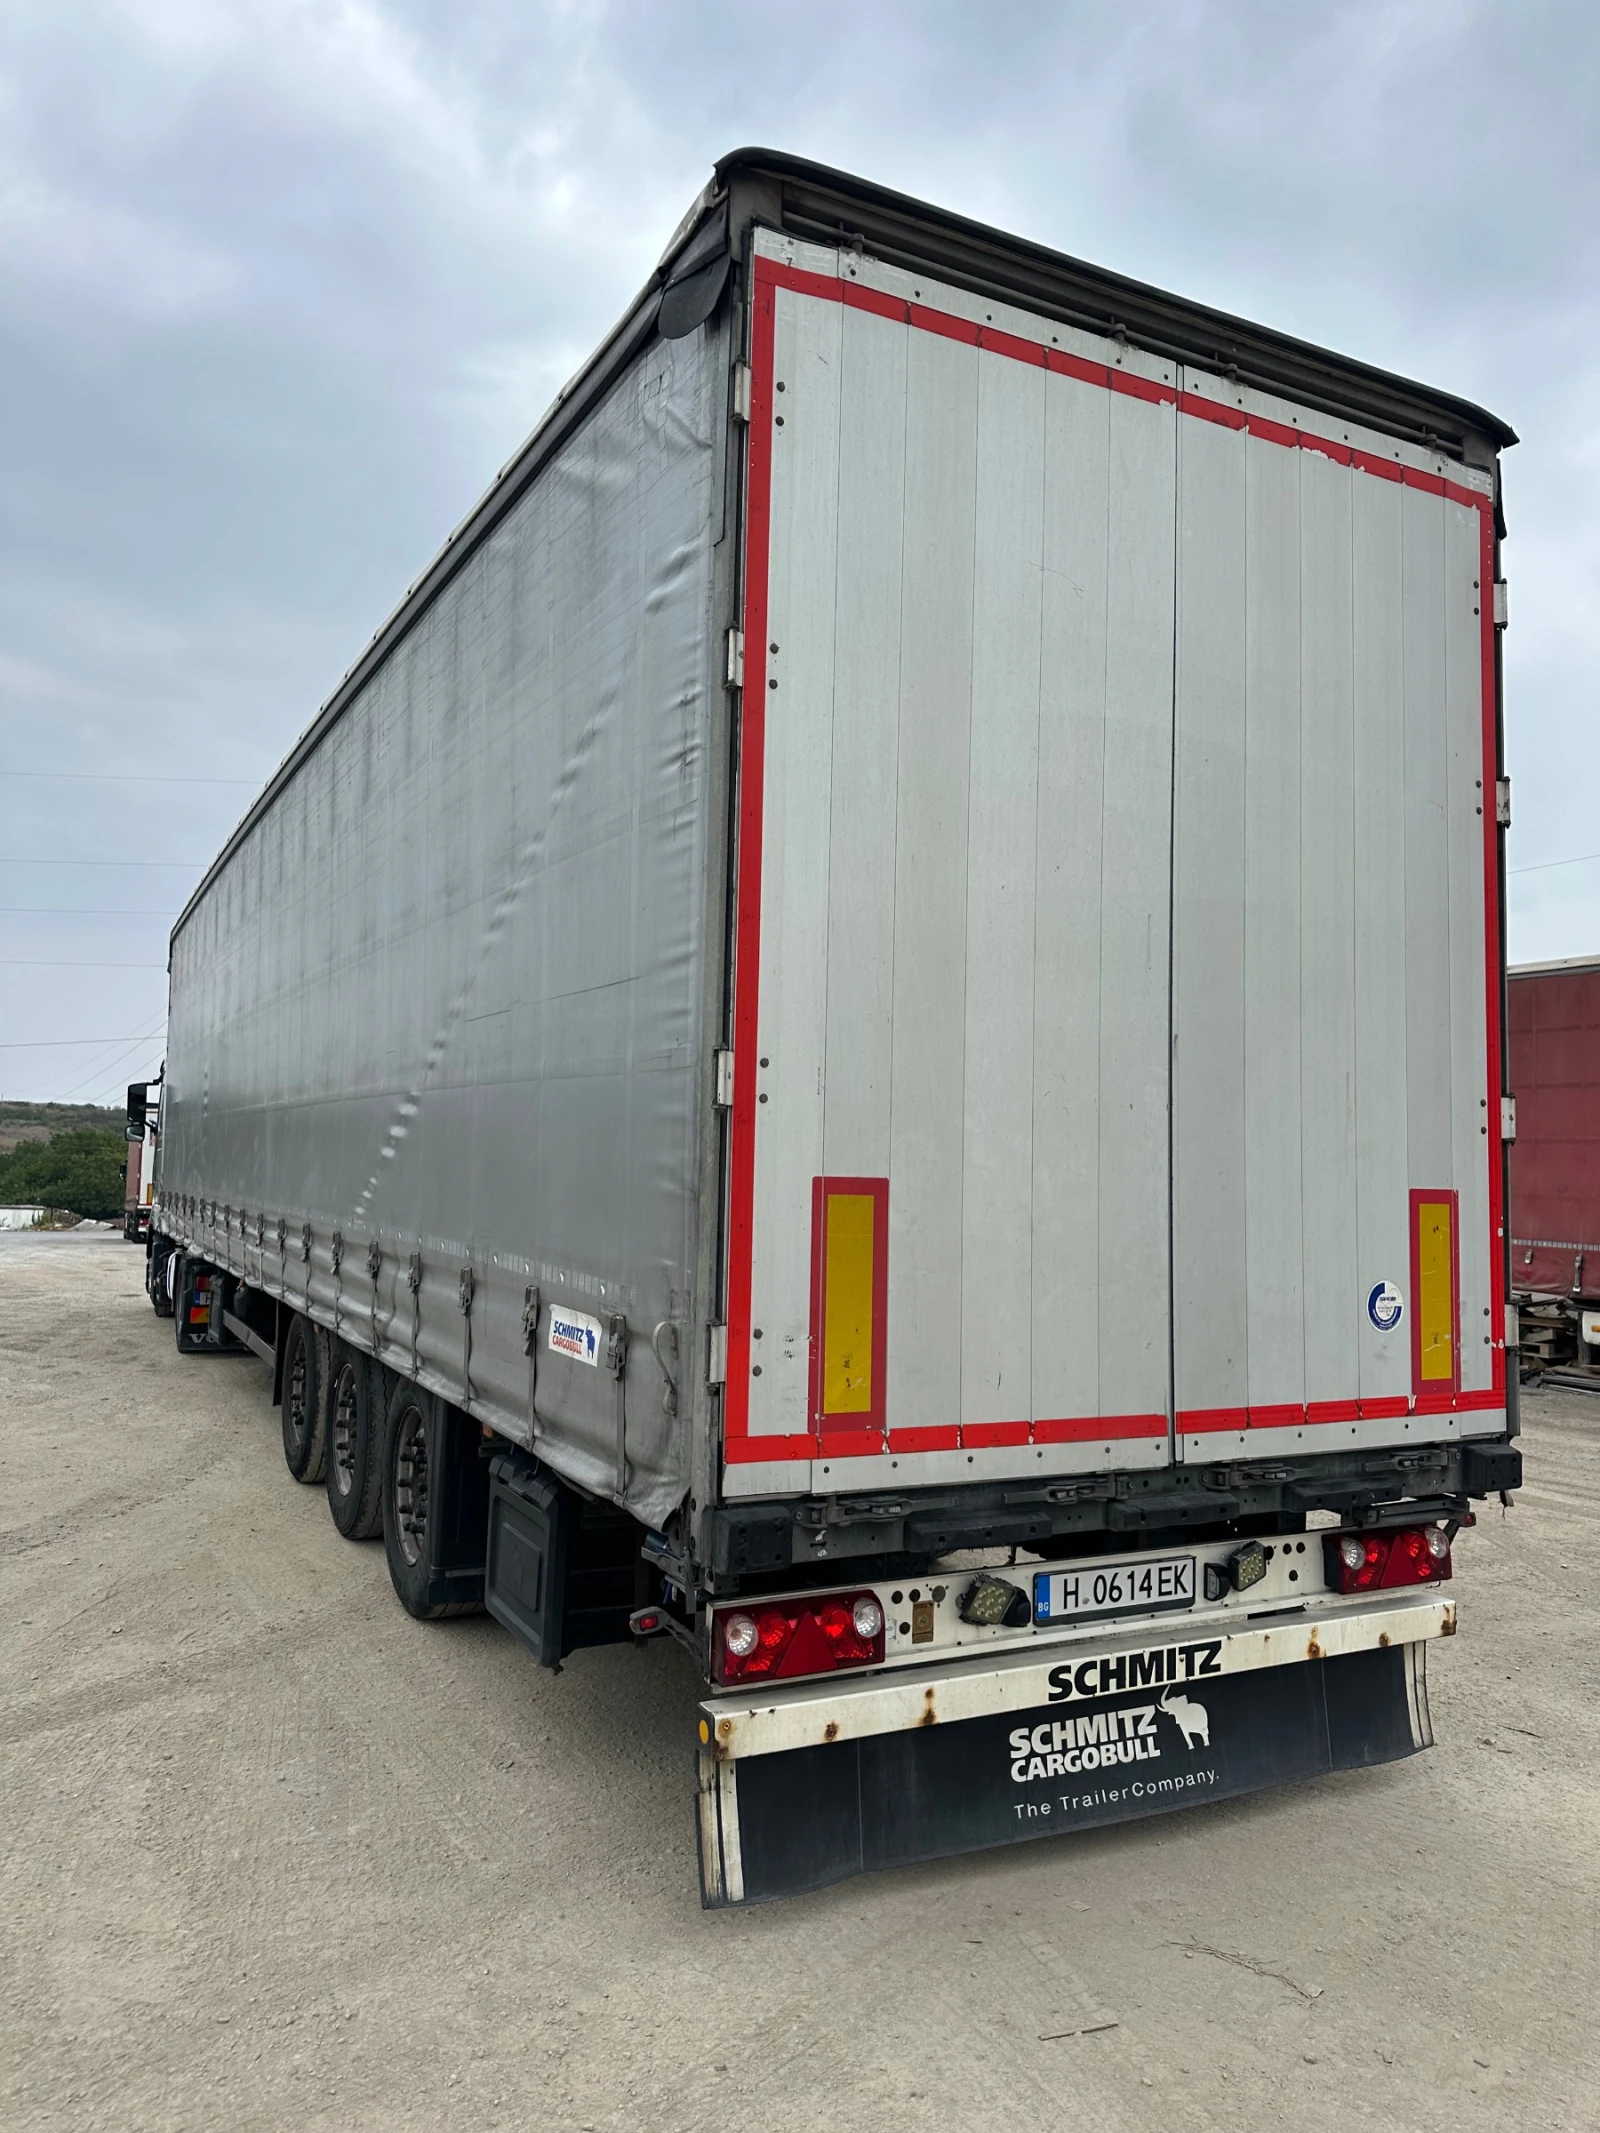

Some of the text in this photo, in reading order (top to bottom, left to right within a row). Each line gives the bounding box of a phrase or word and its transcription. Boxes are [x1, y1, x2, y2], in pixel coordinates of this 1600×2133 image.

[553, 1320, 585, 1343] SCHMITZ
[1037, 1602, 1049, 1612] BG
[1048, 1640, 1222, 1702] SCHMITZ
[1009, 1704, 1158, 1759] SCHMITZ
[1010, 1736, 1161, 1783] CARGOBULL
[1014, 1801, 1052, 1819] The
